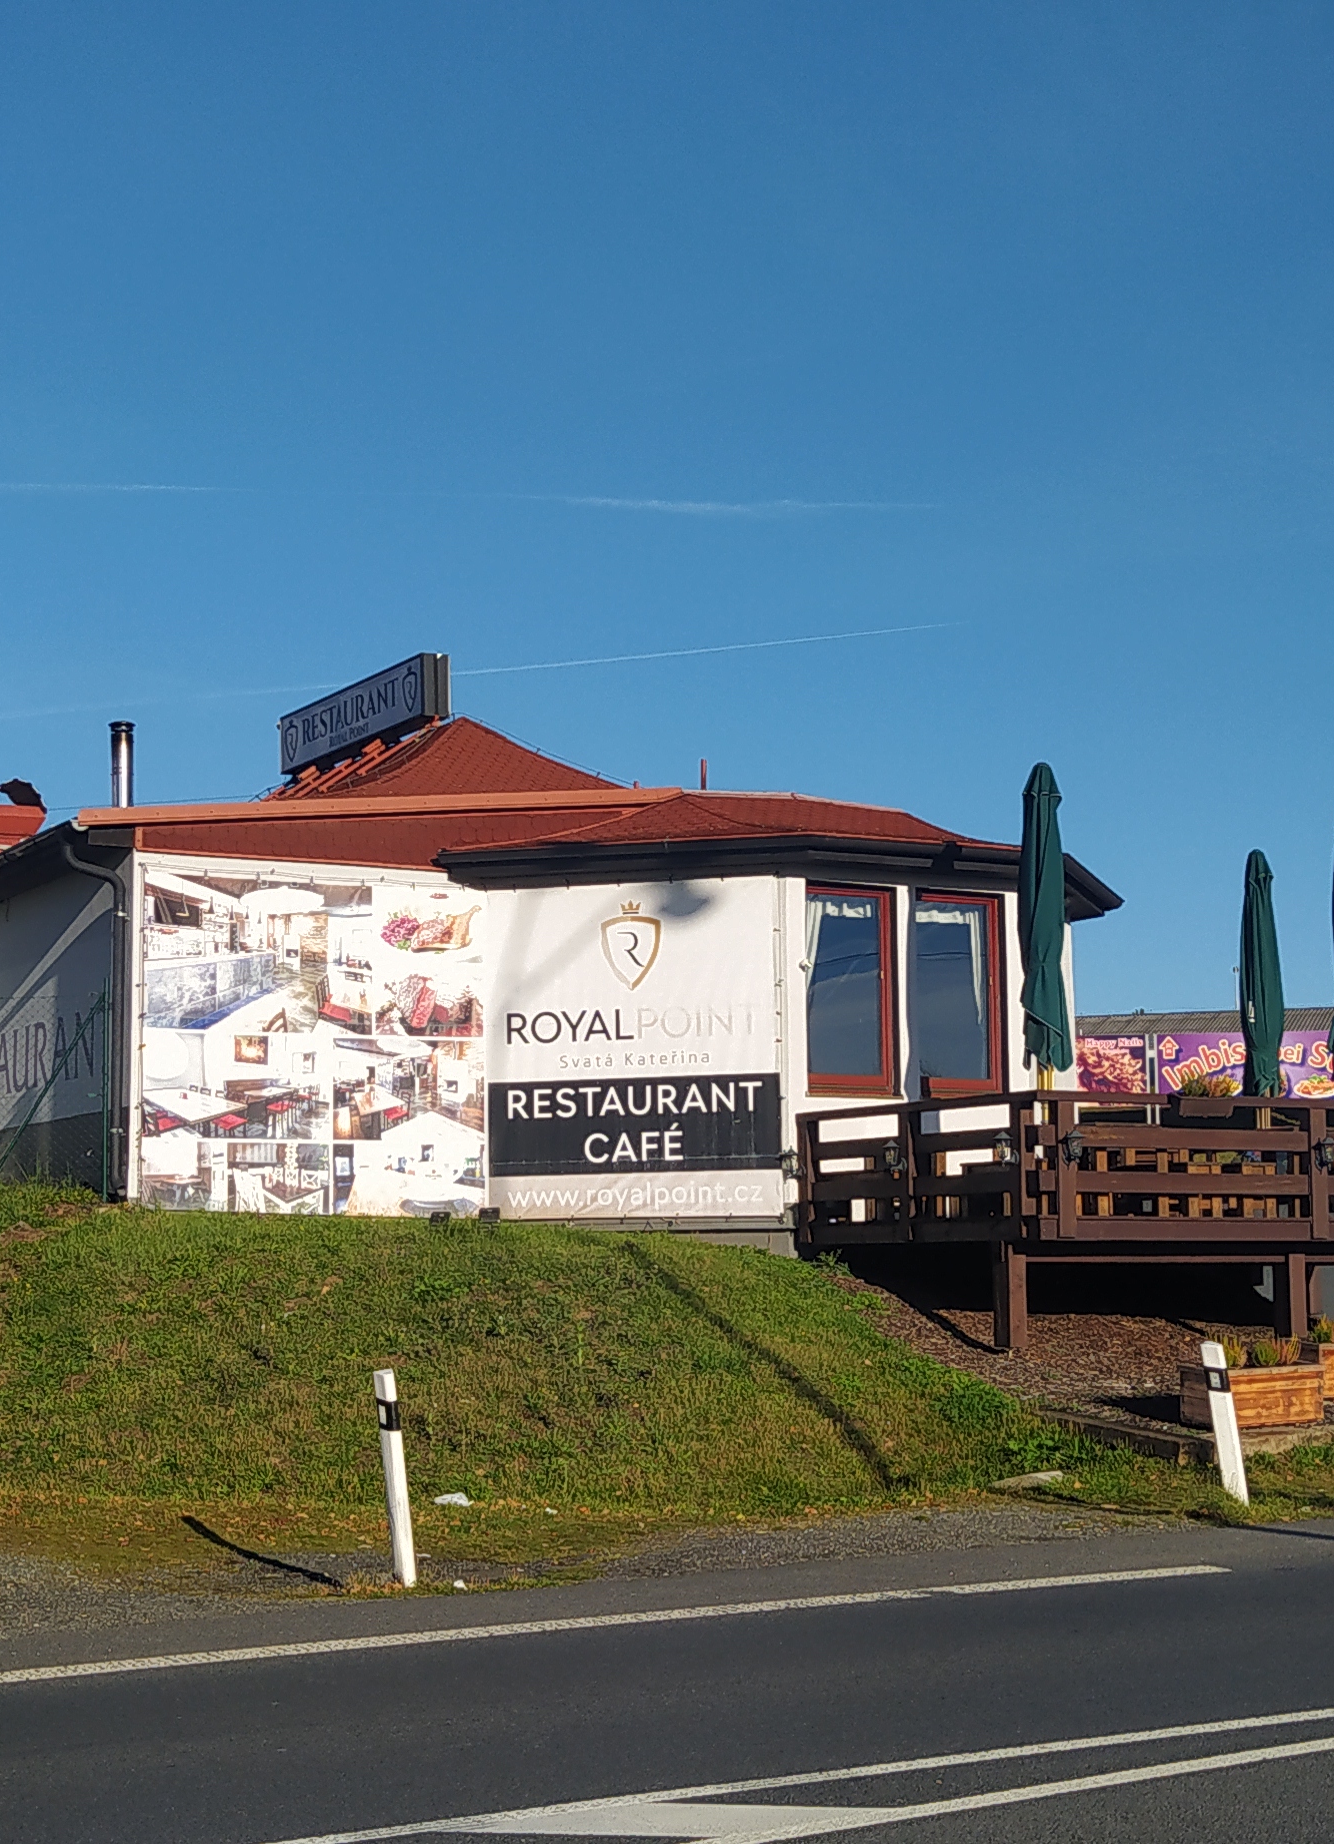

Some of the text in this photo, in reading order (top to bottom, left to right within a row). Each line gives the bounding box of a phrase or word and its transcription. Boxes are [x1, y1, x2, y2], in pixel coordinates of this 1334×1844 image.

[301, 678, 399, 745] RESTAURANT
[349, 723, 369, 741] POINT
[1085, 1037, 1143, 1048] Happy Nails
[560, 1051, 711, 1069] Svatá Kateřina
[1163, 1038, 1246, 1090] Imbis
[507, 1081, 763, 1120] RESTAURANT
[584, 1122, 684, 1164] CAFÉ
[508, 1181, 763, 1211] www.royalpoint.cz
